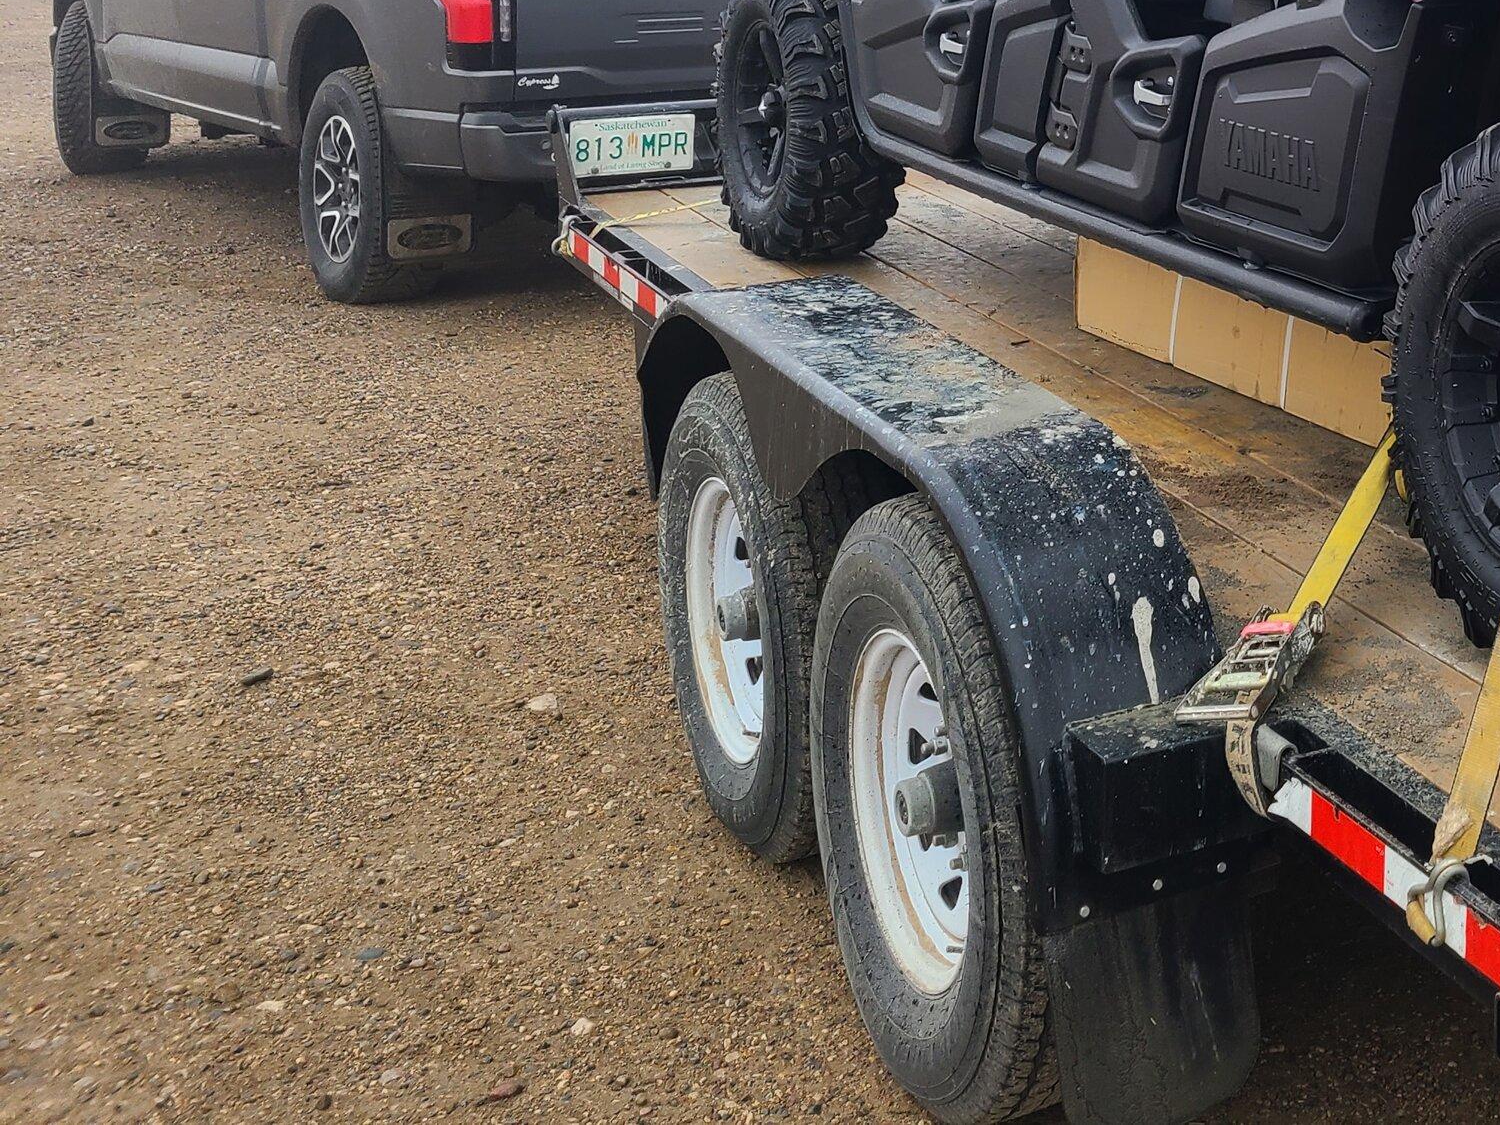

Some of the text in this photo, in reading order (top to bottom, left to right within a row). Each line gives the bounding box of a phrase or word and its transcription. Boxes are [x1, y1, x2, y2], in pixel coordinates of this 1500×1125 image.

[517, 76, 551, 87] Cypress
[598, 119, 668, 132] Saskatchewan
[575, 131, 688, 163] 813 MPR
[1219, 118, 1321, 193] YAMAHA
